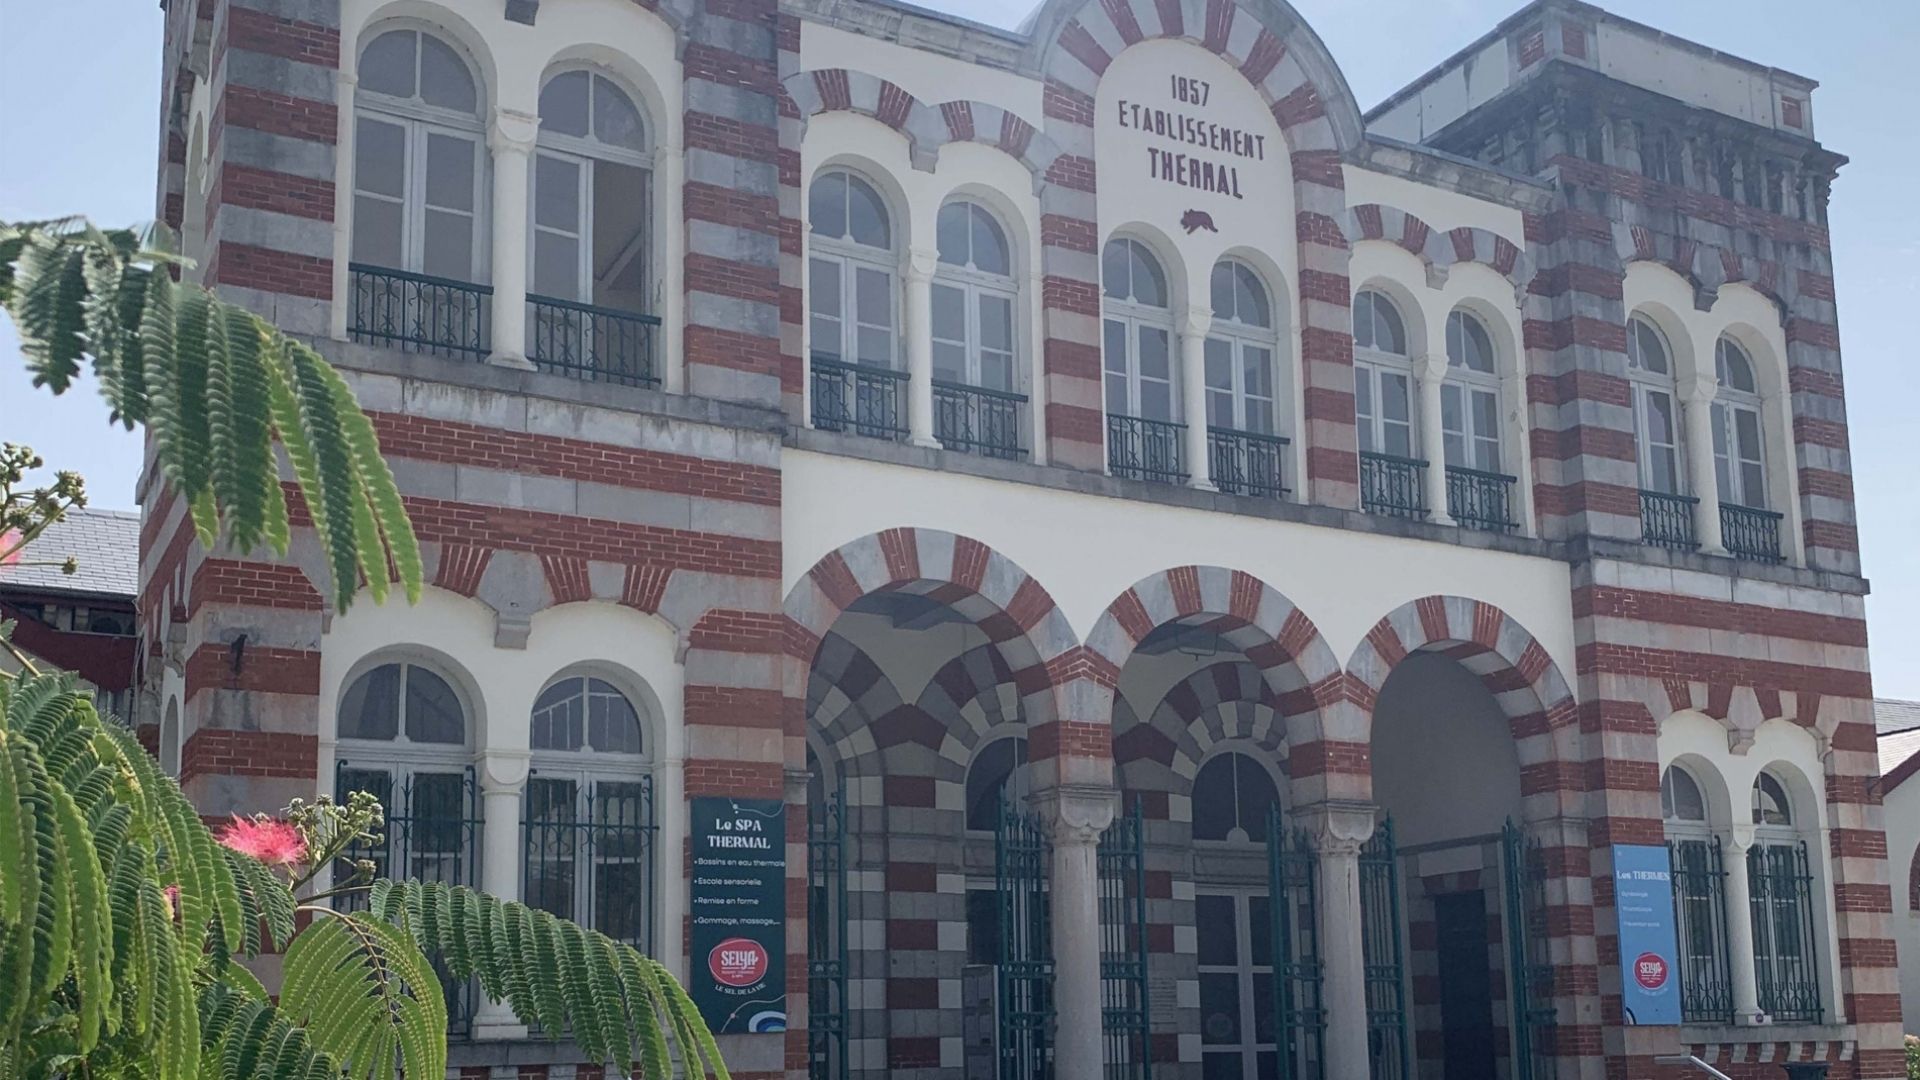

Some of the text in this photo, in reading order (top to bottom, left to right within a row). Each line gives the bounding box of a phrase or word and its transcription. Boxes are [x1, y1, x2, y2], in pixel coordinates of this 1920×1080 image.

[1171, 74, 1210, 107] 1857
[1118, 100, 1265, 160] ETABLISSEMENT
[1147, 147, 1243, 200] THERMAL
[735, 818, 762, 832] SPA
[707, 835, 771, 849] THERMAL
[698, 896, 725, 905] Remise
[737, 897, 759, 905] forme
